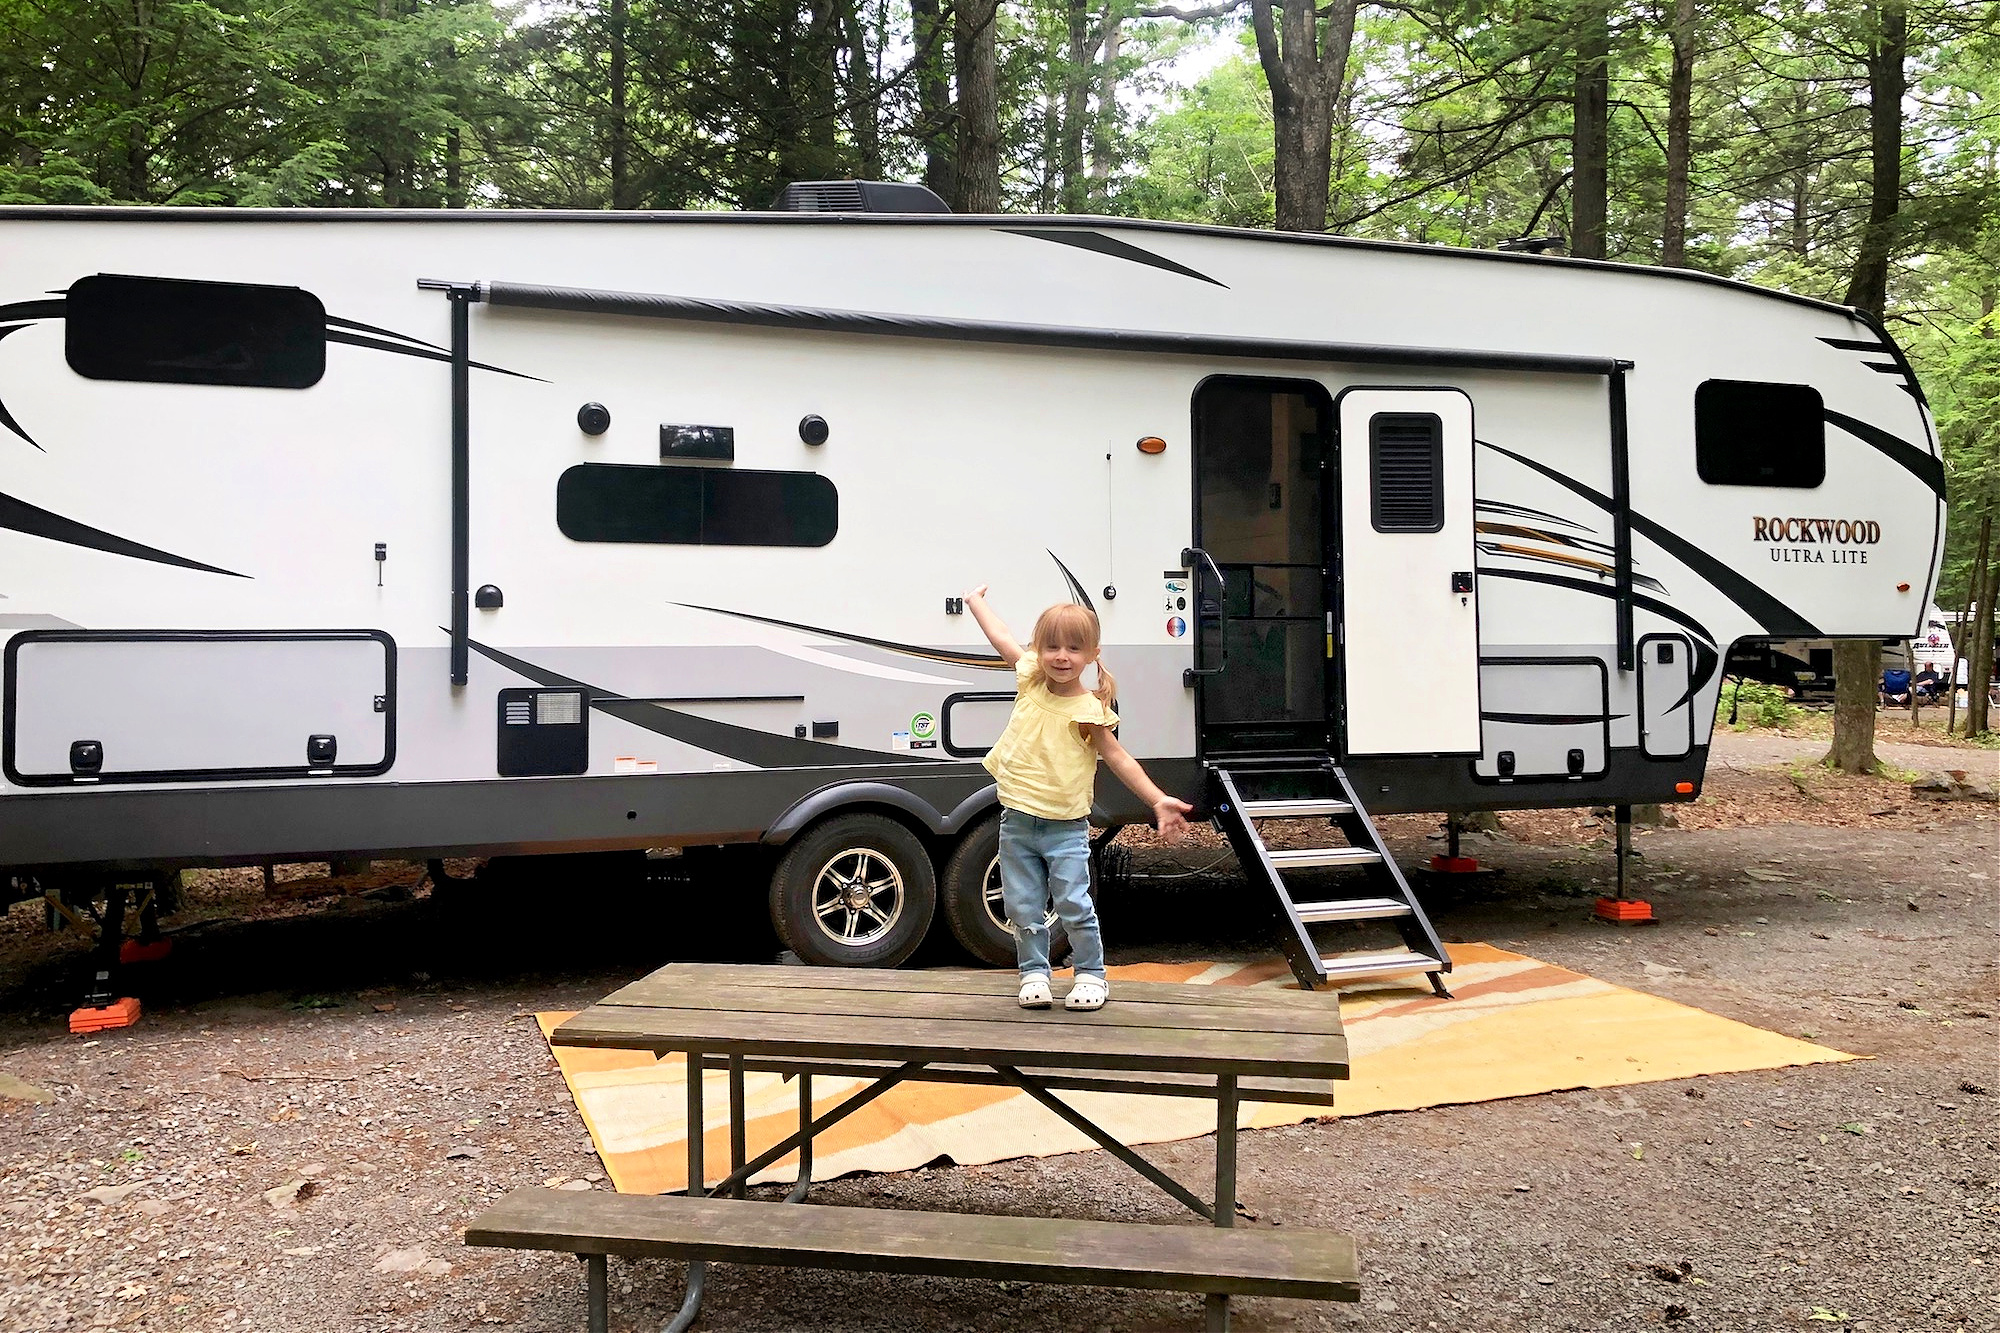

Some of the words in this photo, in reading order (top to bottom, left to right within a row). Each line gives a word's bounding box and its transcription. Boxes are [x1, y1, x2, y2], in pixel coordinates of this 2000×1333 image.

[1753, 516, 1880, 544] ROCKWOOD
[1770, 548, 1824, 563] ULTRA
[1832, 550, 1868, 564] LITE
